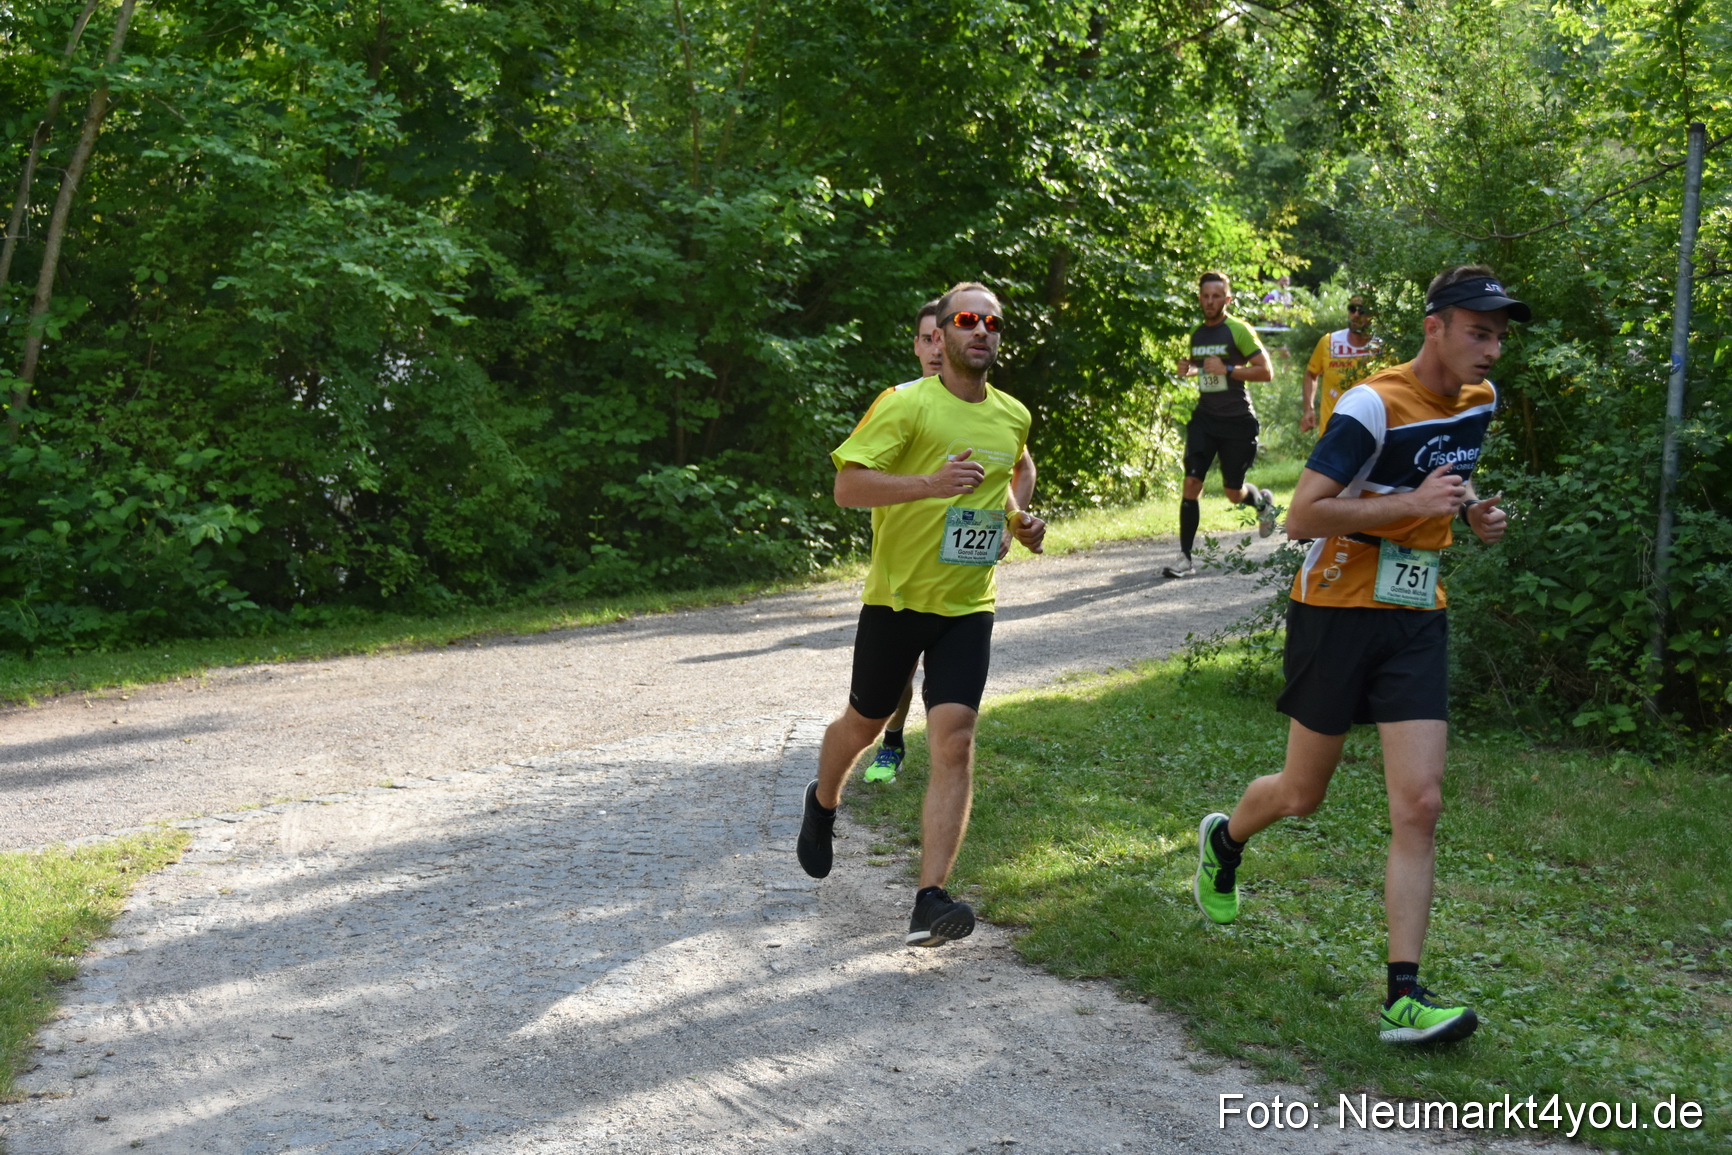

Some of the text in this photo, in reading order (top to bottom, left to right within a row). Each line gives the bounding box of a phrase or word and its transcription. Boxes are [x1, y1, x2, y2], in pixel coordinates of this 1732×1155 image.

[1203, 376, 1219, 385] 338
[1428, 447, 1479, 467] Fischer
[953, 528, 997, 549] 1227
[1395, 563, 1429, 589] 751
[1390, 586, 1411, 594] Gottlieb
